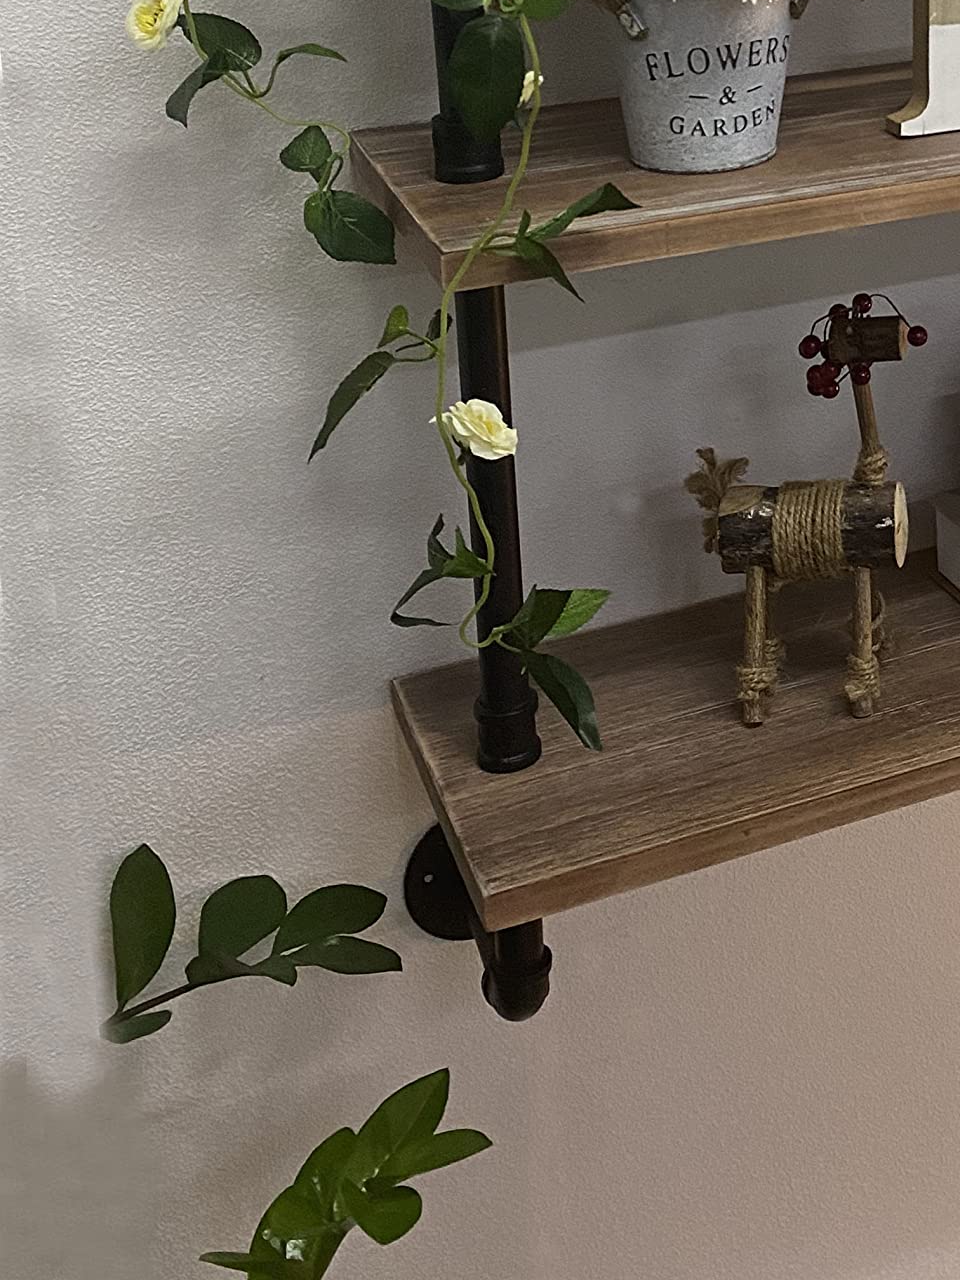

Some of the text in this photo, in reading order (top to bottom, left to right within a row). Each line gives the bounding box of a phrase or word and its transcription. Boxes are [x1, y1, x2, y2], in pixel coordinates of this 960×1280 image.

[645, 35, 790, 81] FLOWERS
[719, 86, 737, 105] &
[669, 100, 776, 137] GARDEN
